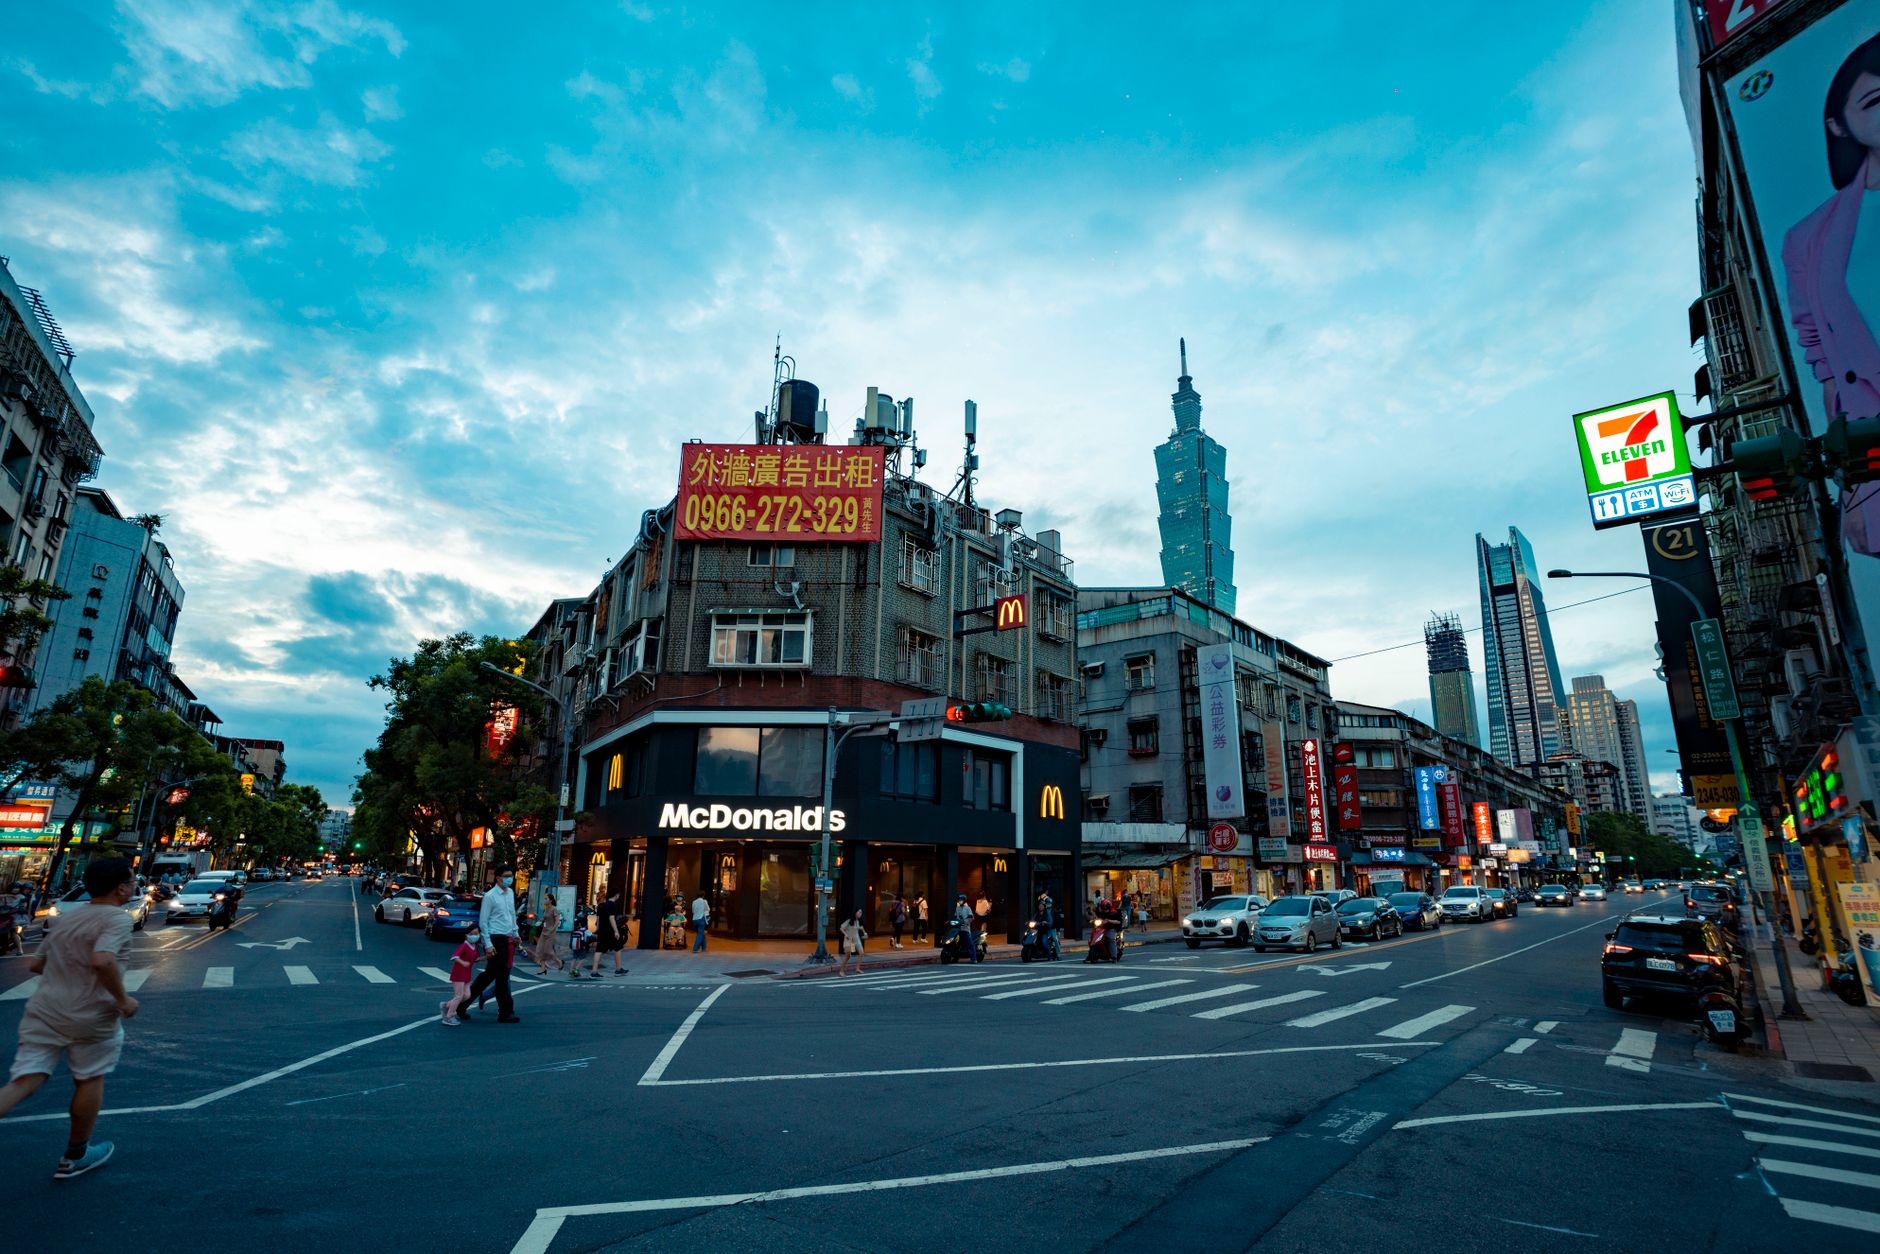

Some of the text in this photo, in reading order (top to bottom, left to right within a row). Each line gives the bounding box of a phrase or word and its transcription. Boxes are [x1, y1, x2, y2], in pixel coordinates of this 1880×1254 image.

[690, 453, 874, 488] 外牆廣告出租
[1630, 488, 1653, 500] ATM
[1664, 487, 1690, 501] Wi-Fi
[685, 494, 859, 533] 0966-272-329
[1209, 684, 1227, 749] 公益彩券
[1304, 753, 1322, 833] 池上木片便當
